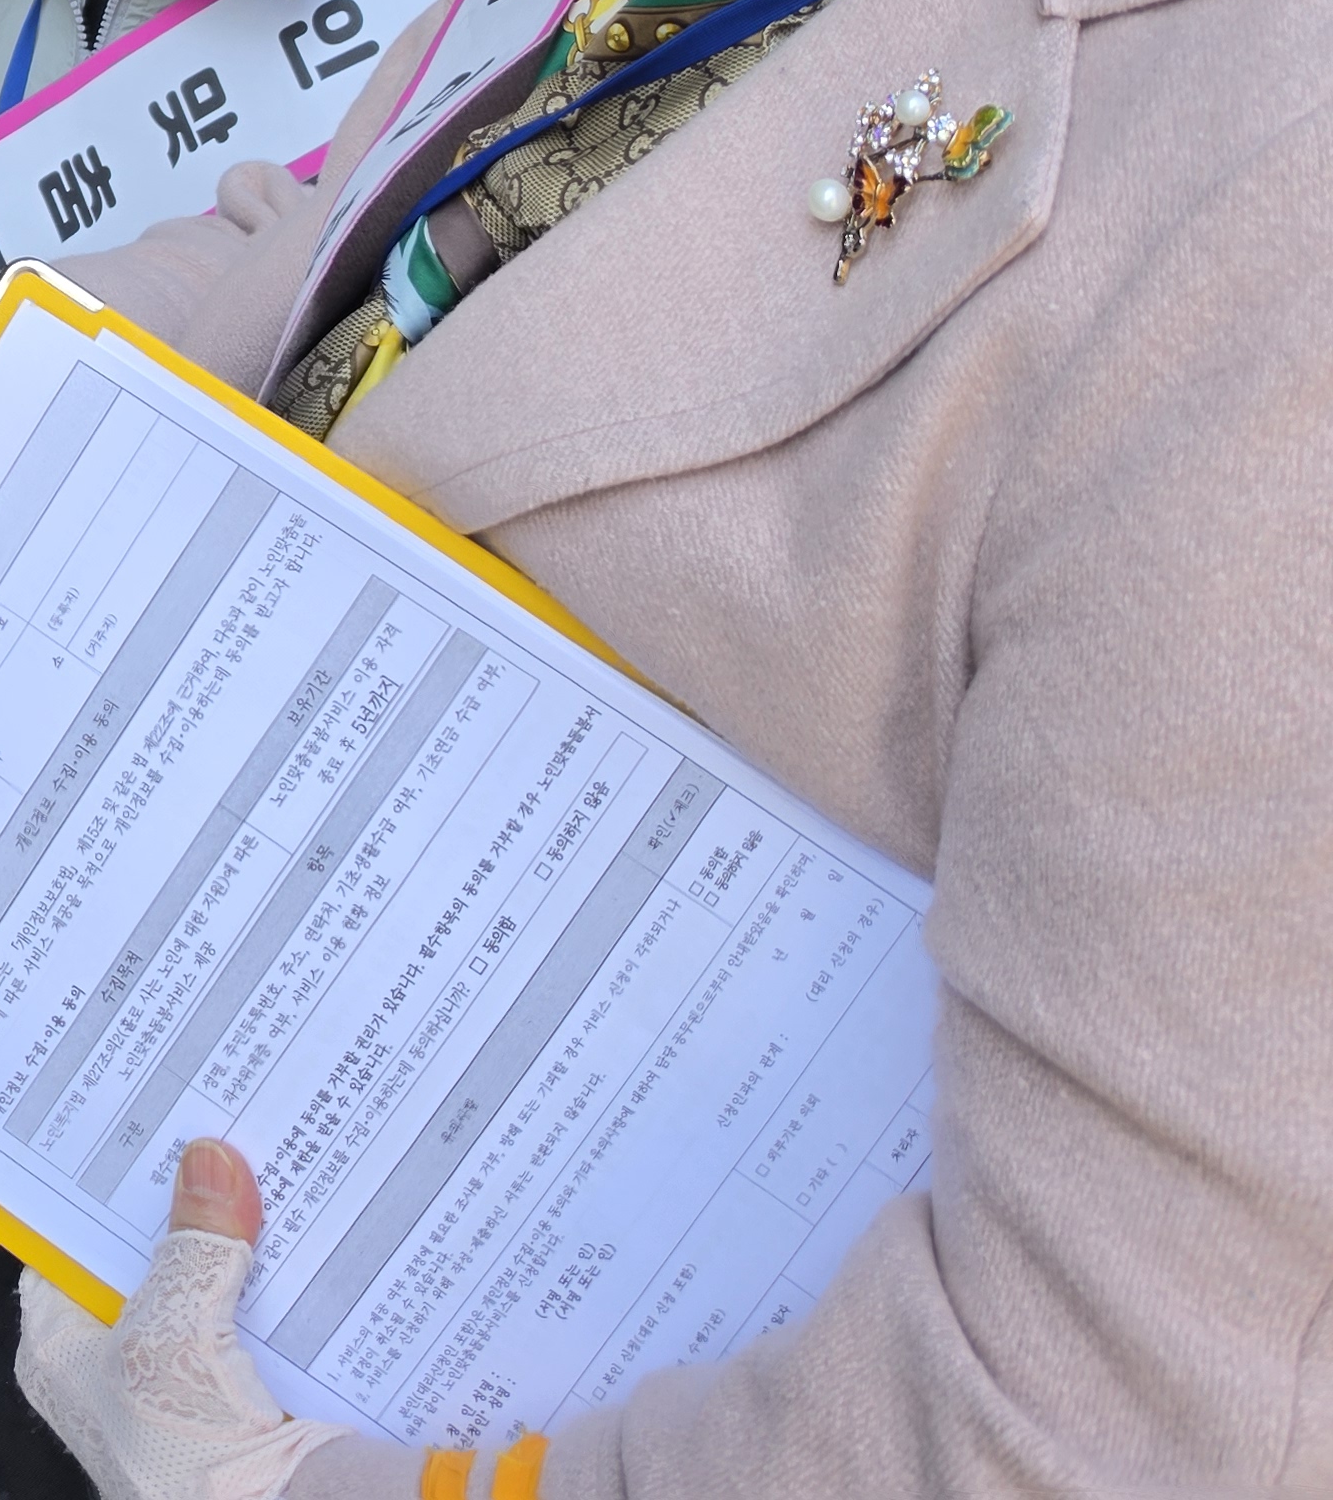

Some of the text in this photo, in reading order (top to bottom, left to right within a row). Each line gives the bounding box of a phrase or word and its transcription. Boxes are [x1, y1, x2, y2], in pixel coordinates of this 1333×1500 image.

[267, 620, 403, 810] 노인맞춤돌봄서비스 이용 자격
[284, 665, 334, 729] 보유기간
[315, 672, 400, 788] 종료 후 5년까지
[12, 794, 57, 853] 개인정보
[90, 696, 120, 730] 동의
[543, 776, 613, 866] 동의하지 않음
[304, 840, 336, 877] 항목
[479, 911, 519, 957] 동의함
[58, 982, 87, 1014] 동의
[97, 948, 144, 1007] 수집목적
[114, 938, 220, 1084] 노인맞춤돌봄서비스 제공
[116, 1118, 147, 1152] 구분
